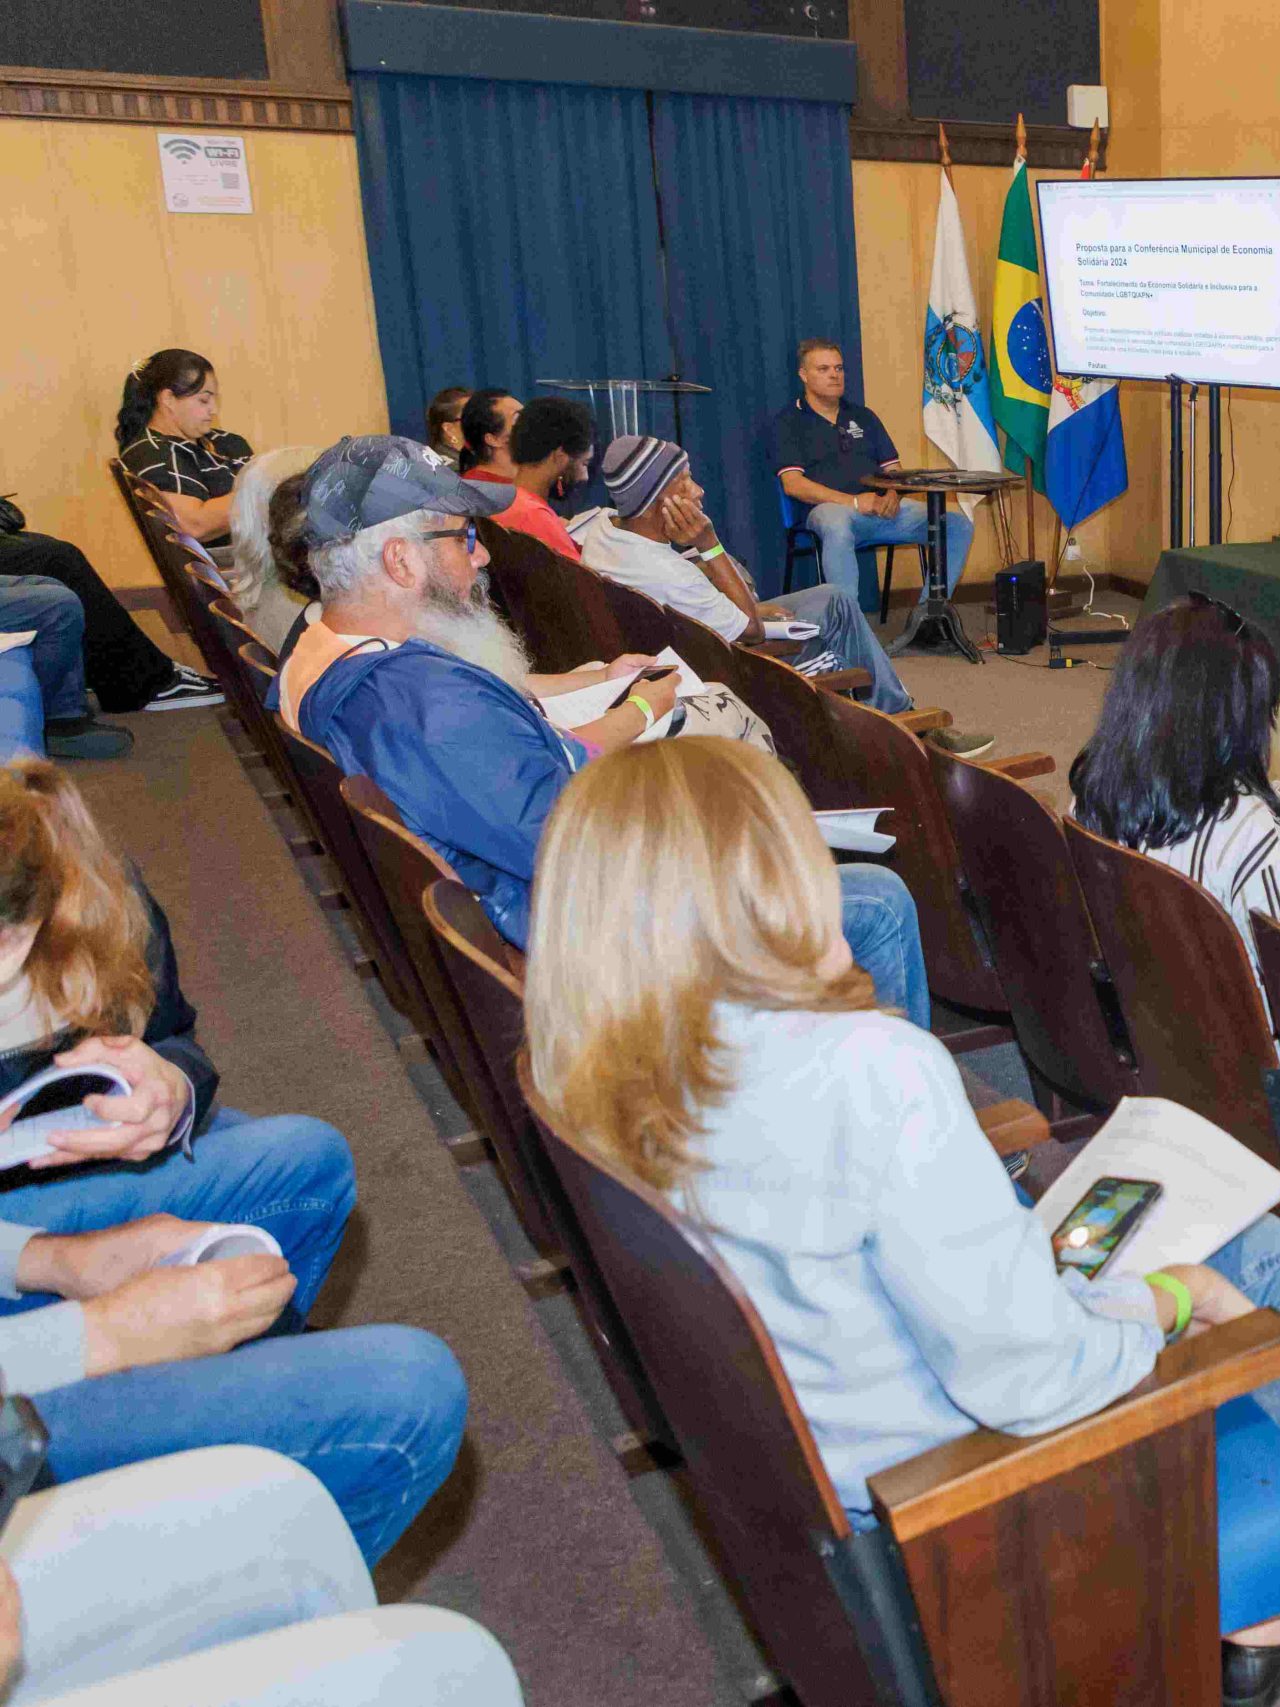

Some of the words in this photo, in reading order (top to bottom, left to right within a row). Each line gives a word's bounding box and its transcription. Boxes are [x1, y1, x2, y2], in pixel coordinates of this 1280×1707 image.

[1076, 243, 1108, 254] Proposta
[1110, 245, 1126, 254] para
[1134, 243, 1179, 253] Conferência
[1181, 244, 1218, 255] Municipal
[1220, 245, 1230, 254] de
[1232, 245, 1273, 254] Economia
[1077, 257, 1108, 266] Solidária
[1111, 258, 1127, 266] 2024
[1177, 282, 1203, 290] Solidária
[1210, 283, 1237, 291] Inclusiva
[1238, 284, 1252, 292] para
